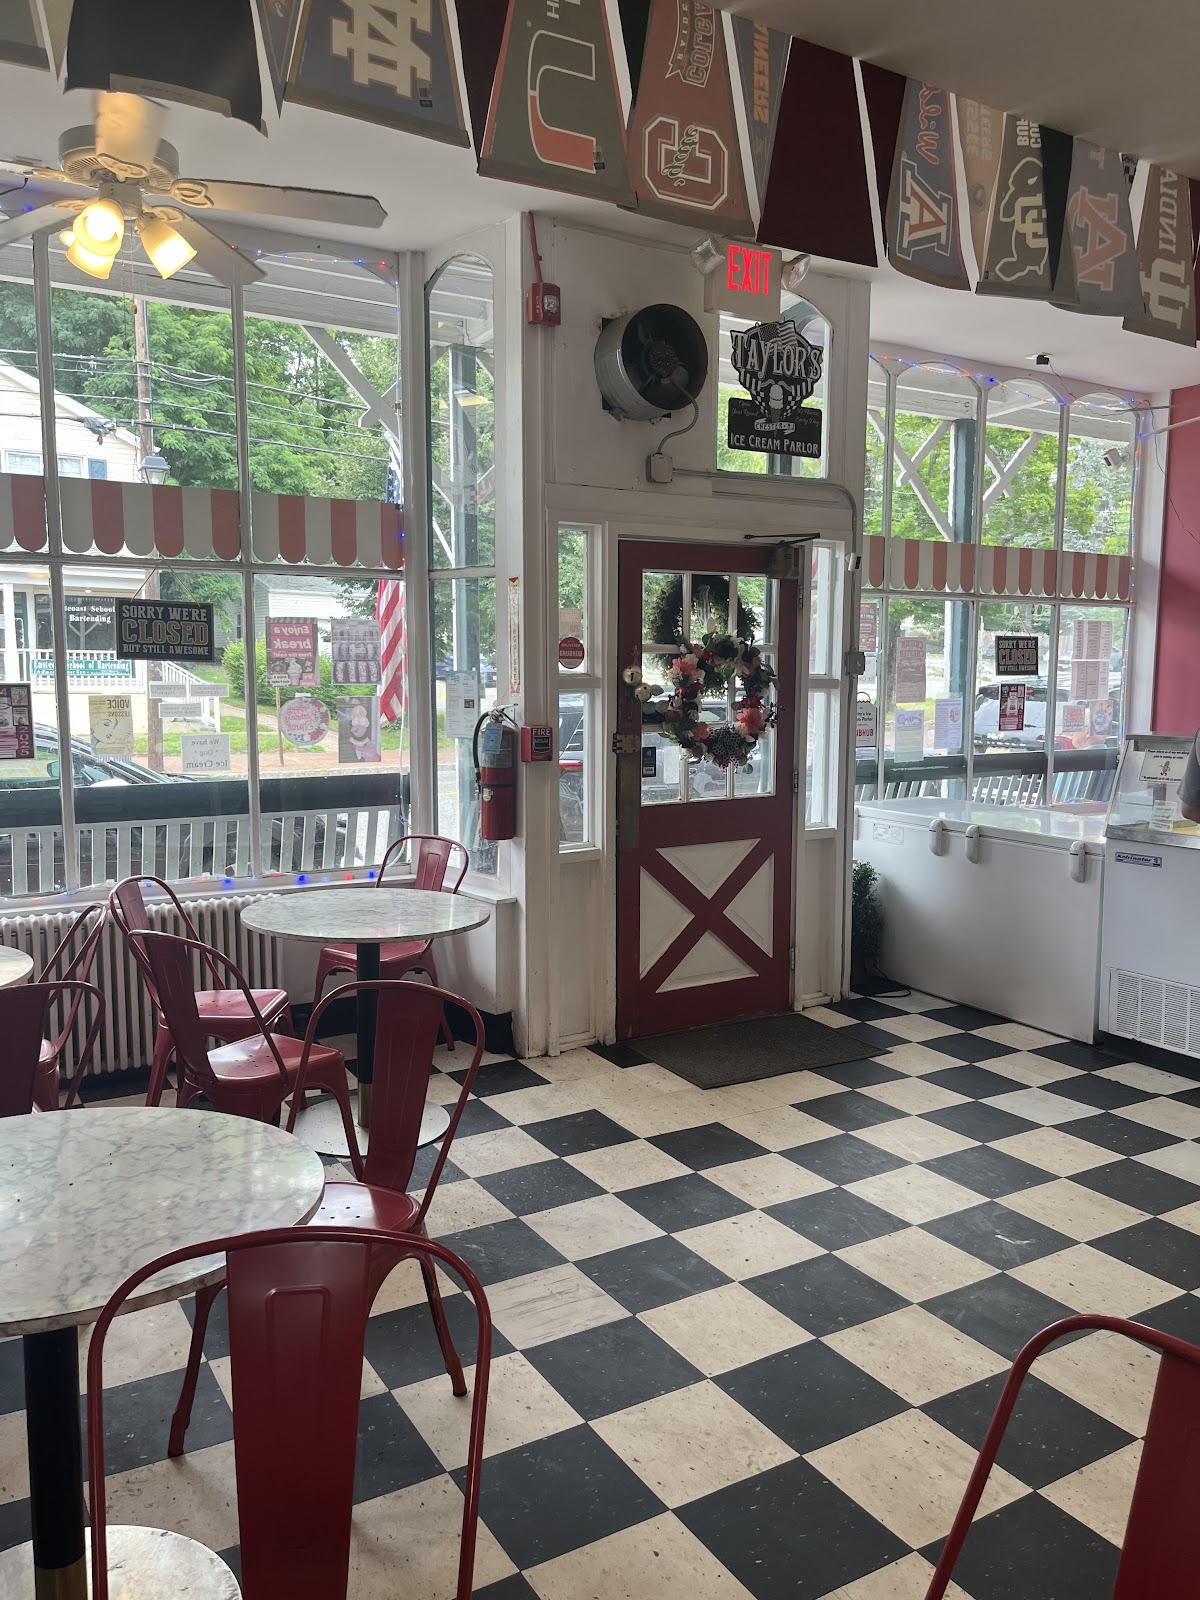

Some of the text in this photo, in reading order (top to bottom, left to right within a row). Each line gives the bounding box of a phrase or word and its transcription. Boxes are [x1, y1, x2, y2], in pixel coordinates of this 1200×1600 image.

[727, 244, 772, 295] EXIT
[732, 331, 822, 380] TAYLOR'S
[730, 432, 819, 454] ICE CREAM PARLOR
[69, 614, 111, 624] Bartending
[122, 605, 207, 621] SORRY WE'RE
[121, 619, 209, 645] CLOSED
[122, 644, 209, 655] BUT STILL AWESOME
[998, 648, 1037, 665] CLOSED
[98, 660, 129, 671] Bartending
[532, 728, 551, 736] FIRE
[19, 726, 31, 756] 2025
